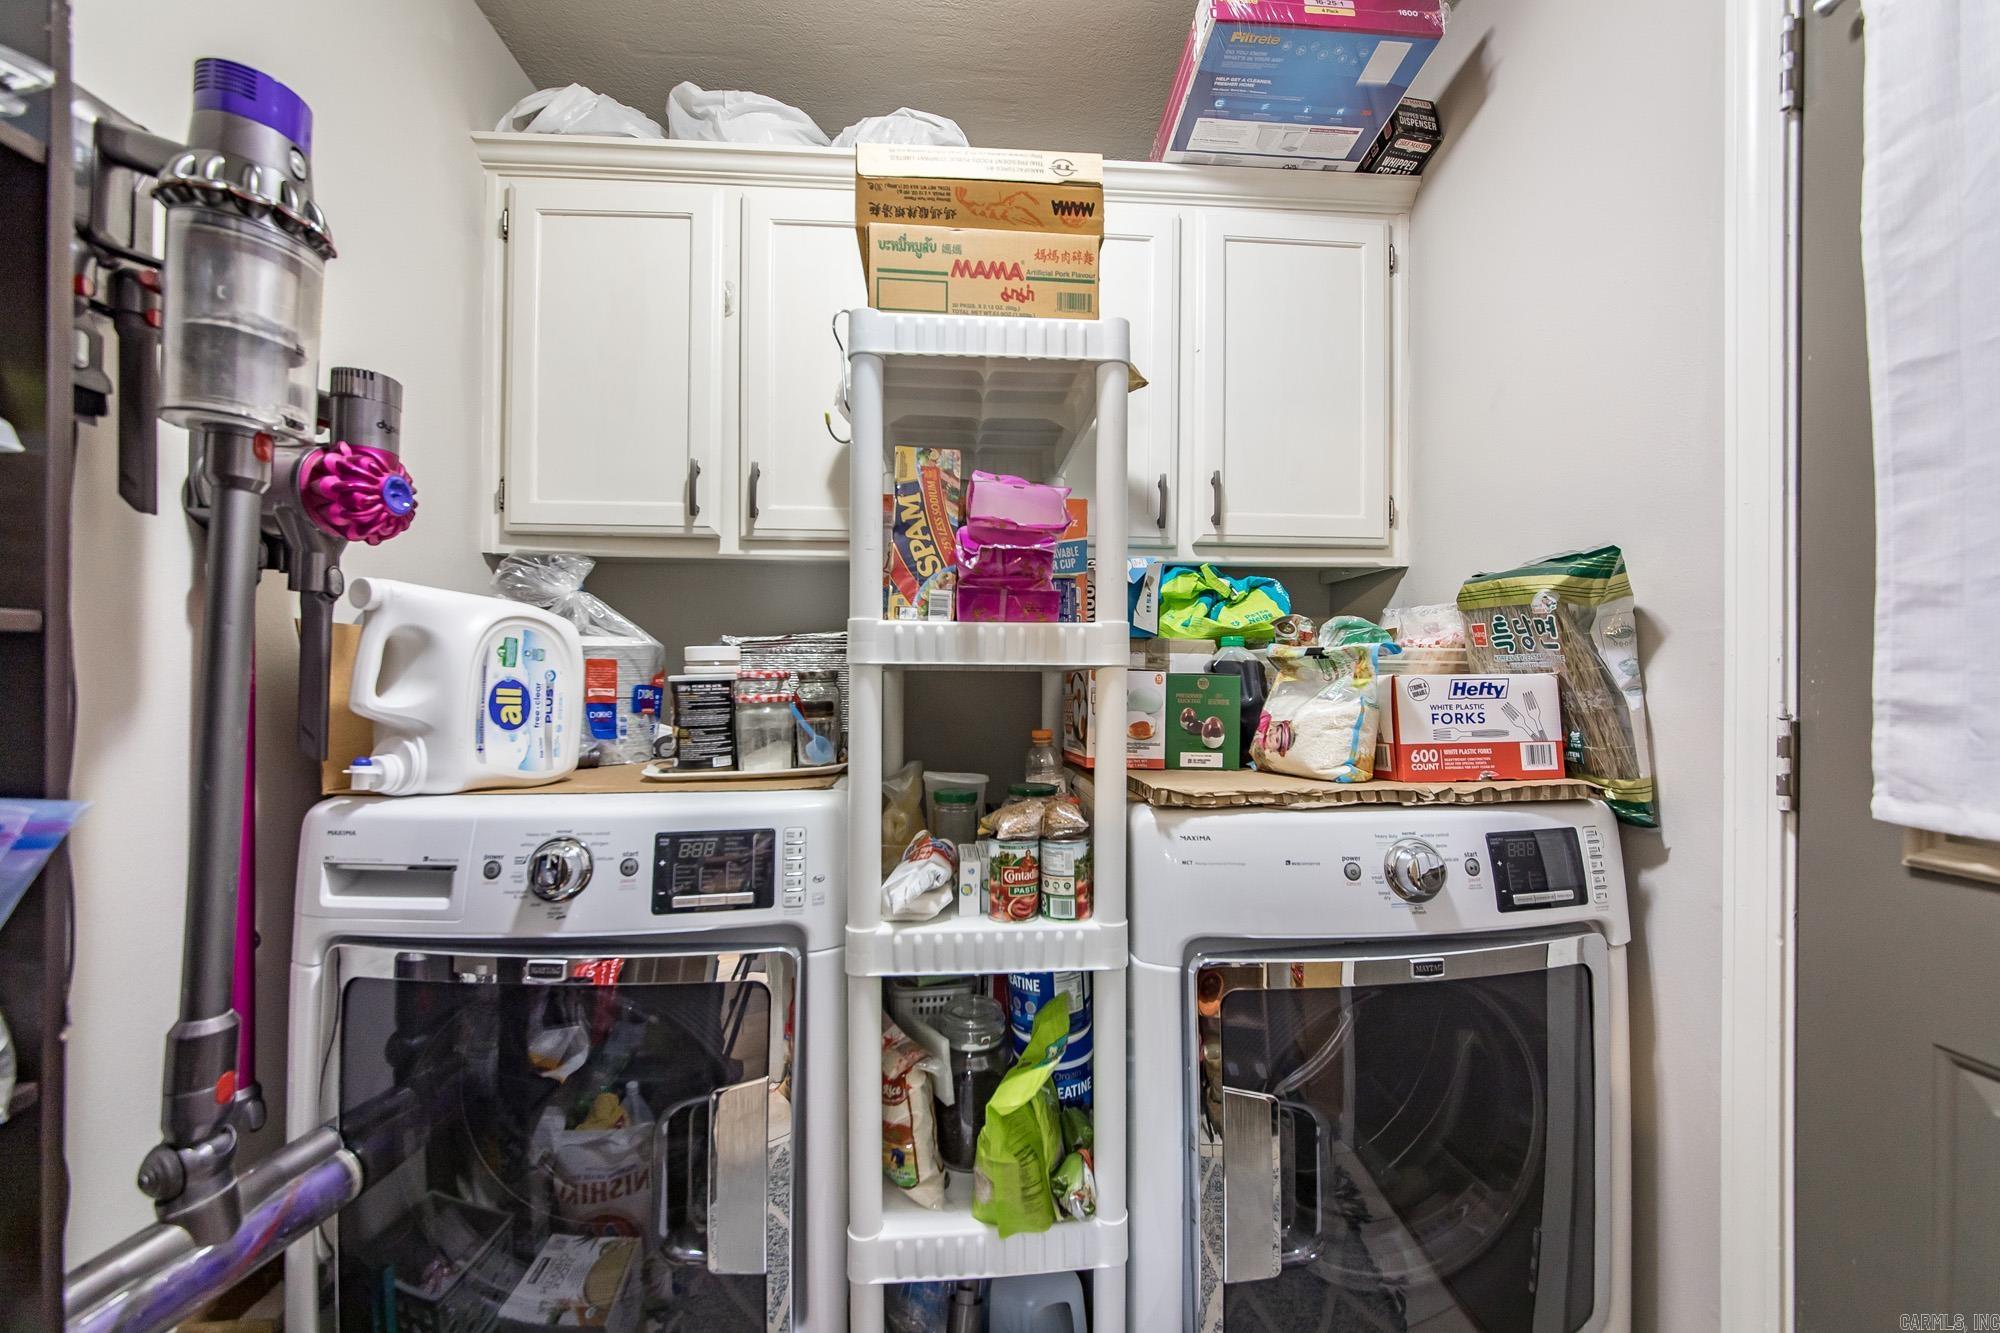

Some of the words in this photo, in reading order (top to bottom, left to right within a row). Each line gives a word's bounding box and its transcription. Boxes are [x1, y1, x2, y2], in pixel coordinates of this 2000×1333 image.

[1399, 9, 1418, 17] 1600
[1230, 31, 1281, 45] Filtrete
[1399, 115, 1437, 131] DISPENSER
[1381, 156, 1418, 171] WHIPPED
[1051, 199, 1096, 218] MAMA
[950, 259, 1025, 281] MAMA
[1026, 268, 1054, 278] Artificial
[1054, 270, 1070, 279] Pork
[927, 480, 941, 515] SODIUM
[897, 492, 942, 578] SPAM
[1059, 559, 1077, 570] CUP
[533, 682, 542, 706] clear
[1452, 681, 1505, 699] Hefty
[495, 687, 523, 726] all
[544, 688, 554, 725] PLUS
[1429, 703, 1454, 711] WHITE
[1455, 703, 1485, 711] PLASTIC
[533, 711, 542, 729] free
[1431, 712, 1486, 725] FORKS
[1410, 748, 1439, 763] 600
[1458, 747, 1477, 755] PLASTIC
[1477, 747, 1492, 755] FORKS
[1411, 762, 1440, 771] COUNT
[483, 854, 505, 862] power
[622, 850, 639, 858] start
[1341, 855, 1362, 863] power
[1415, 964, 1442, 973] MAYTAG
[1057, 1076, 1092, 1101] EATINE
